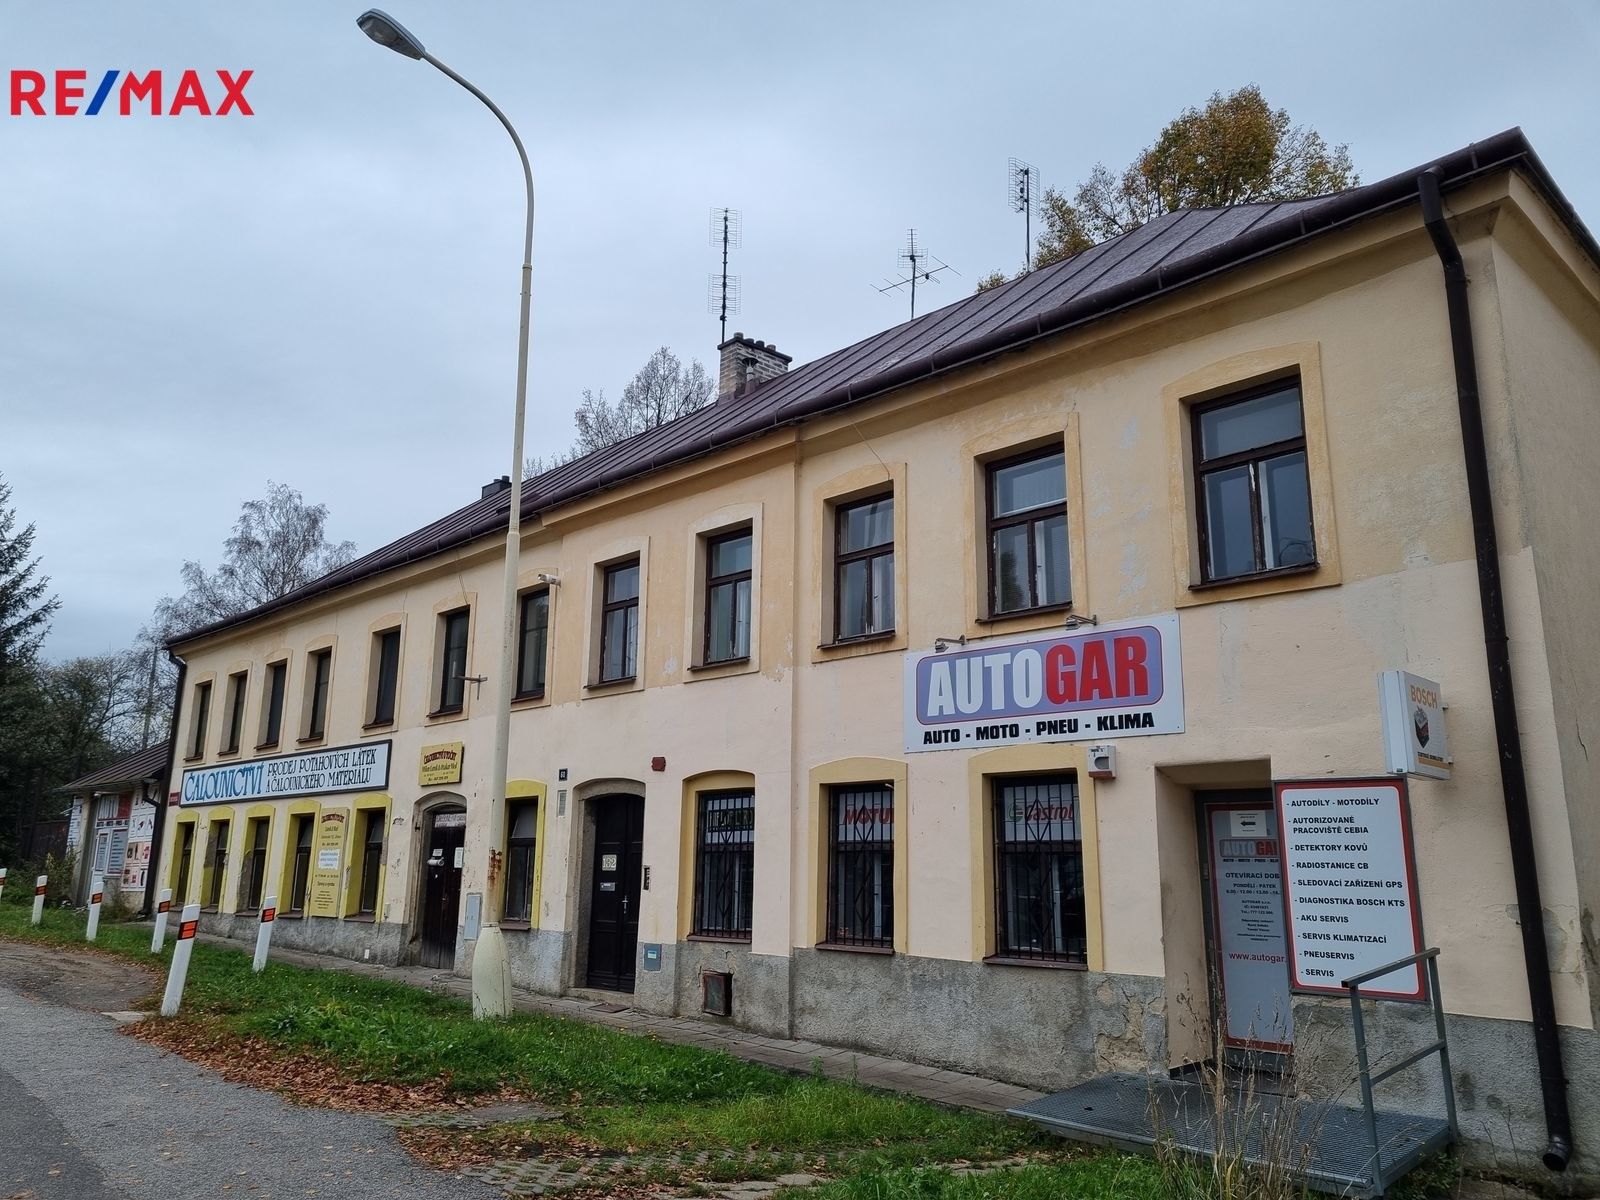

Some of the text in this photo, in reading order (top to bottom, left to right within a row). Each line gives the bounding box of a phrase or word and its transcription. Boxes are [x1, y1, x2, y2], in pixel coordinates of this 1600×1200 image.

[927, 636, 1149, 717] AUTOGAR
[1410, 684, 1438, 709] BOSCH
[923, 729, 961, 745] AUTO
[976, 724, 1020, 740] MOTO
[1036, 718, 1079, 735] PNEU
[1097, 712, 1155, 730] KLIMA
[268, 748, 377, 777] PRODEJ POTAHOVÝCH LÁTEK
[184, 762, 264, 801] ČALOUNICTVÍ
[265, 767, 372, 793] A ČALOUNICKÉHO MATERIÁLU
[1291, 798, 1330, 807] AUTODÍLY
[1337, 797, 1380, 806] MOTODÍLY
[1293, 816, 1354, 824] AUTORIZOVANÉ
[1344, 826, 1369, 834] CEBIA
[1344, 843, 1368, 851] KOVŮ
[1297, 879, 1342, 887] SLEDOVACÍ
[1344, 879, 1383, 888] ZAŘÍZENÍ
[1299, 897, 1354, 905] DIAGNOSTIKA
[1357, 898, 1385, 906] BOSCH
[1388, 899, 1405, 907] KTS
[1320, 915, 1349, 923] SERVIS
[1333, 935, 1387, 943] KLIMATIZACÍ
[1304, 950, 1355, 960] PNEUSERVIS
[1305, 969, 1335, 977] SERVIS
